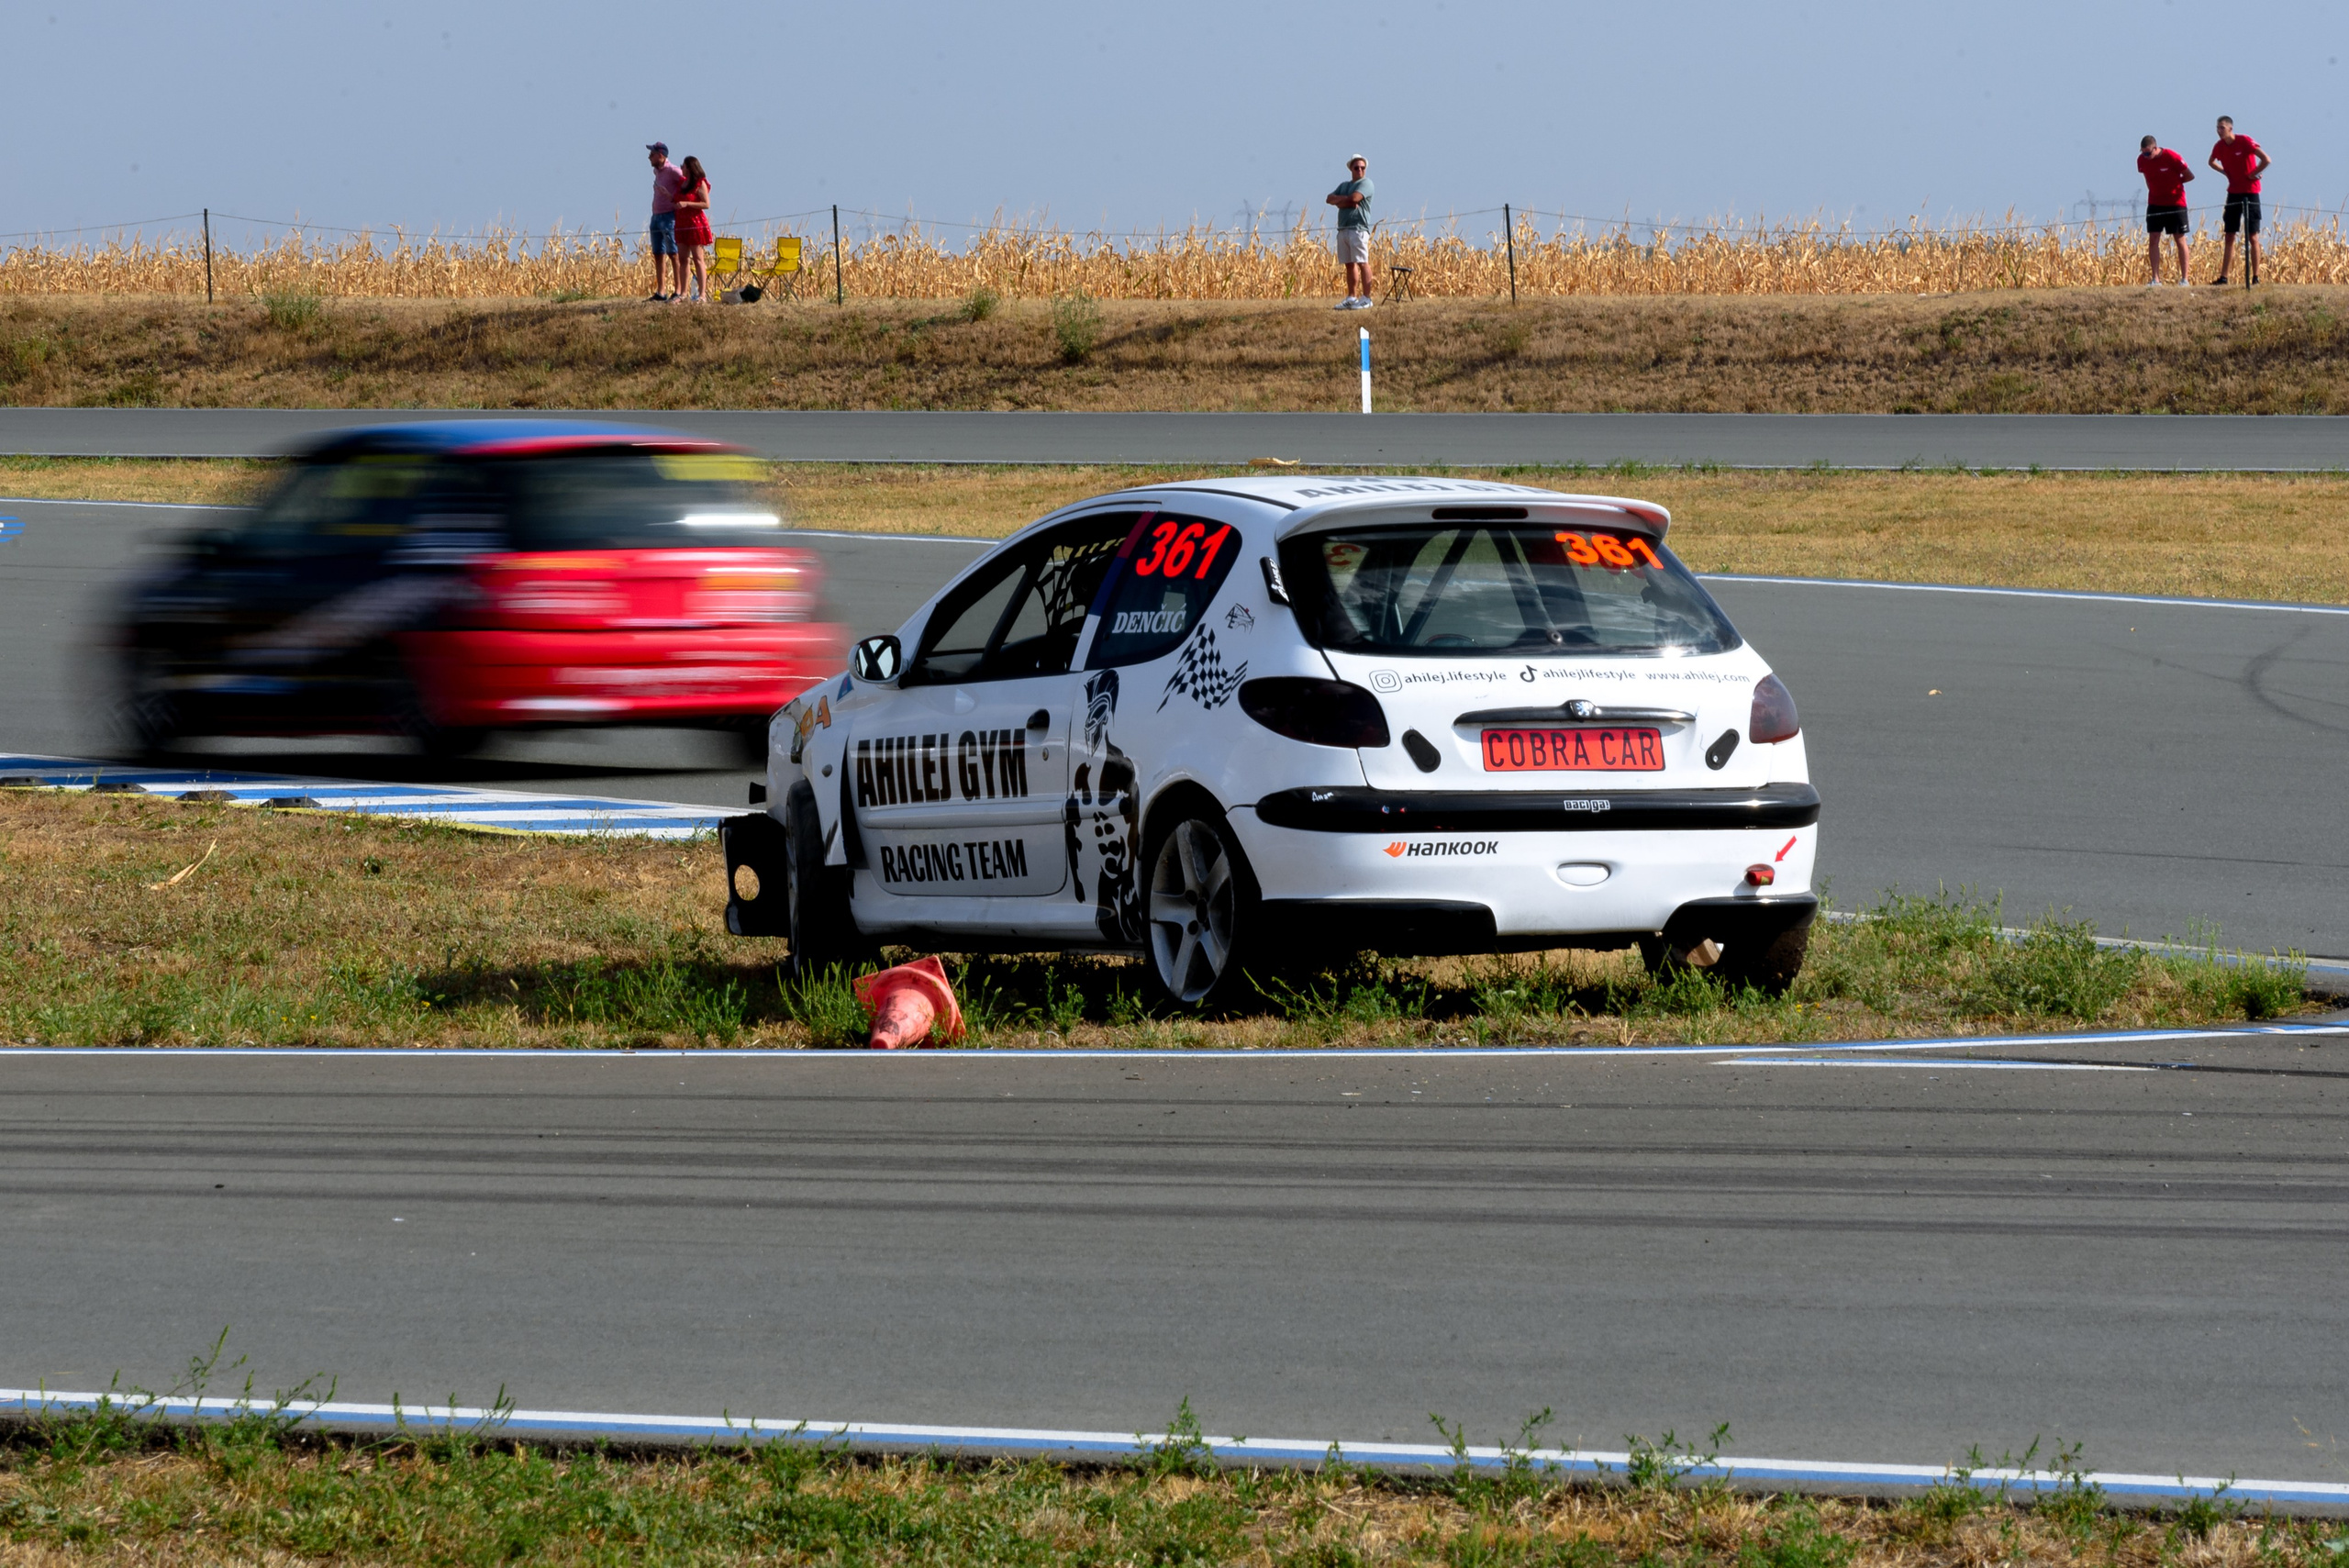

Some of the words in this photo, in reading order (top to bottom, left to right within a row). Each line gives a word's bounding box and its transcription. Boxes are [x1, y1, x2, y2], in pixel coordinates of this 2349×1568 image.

[1294, 484, 1455, 499] AHILEJ
[1135, 521, 1232, 580] 361
[1554, 532, 1664, 570] 361
[1111, 603, 1187, 634] DENČIĆ
[1405, 670, 1508, 684] ahilej.lifestyle
[1543, 669, 1637, 682] ahilejlifestyle
[1645, 670, 1751, 684] www.ahilej.com
[1487, 732, 1590, 767] COBRA
[1599, 731, 1657, 766] CAR
[857, 733, 952, 808] AHILEJ
[958, 728, 1029, 802] GYM
[880, 842, 965, 884] RACING
[963, 839, 1029, 881] TEAM
